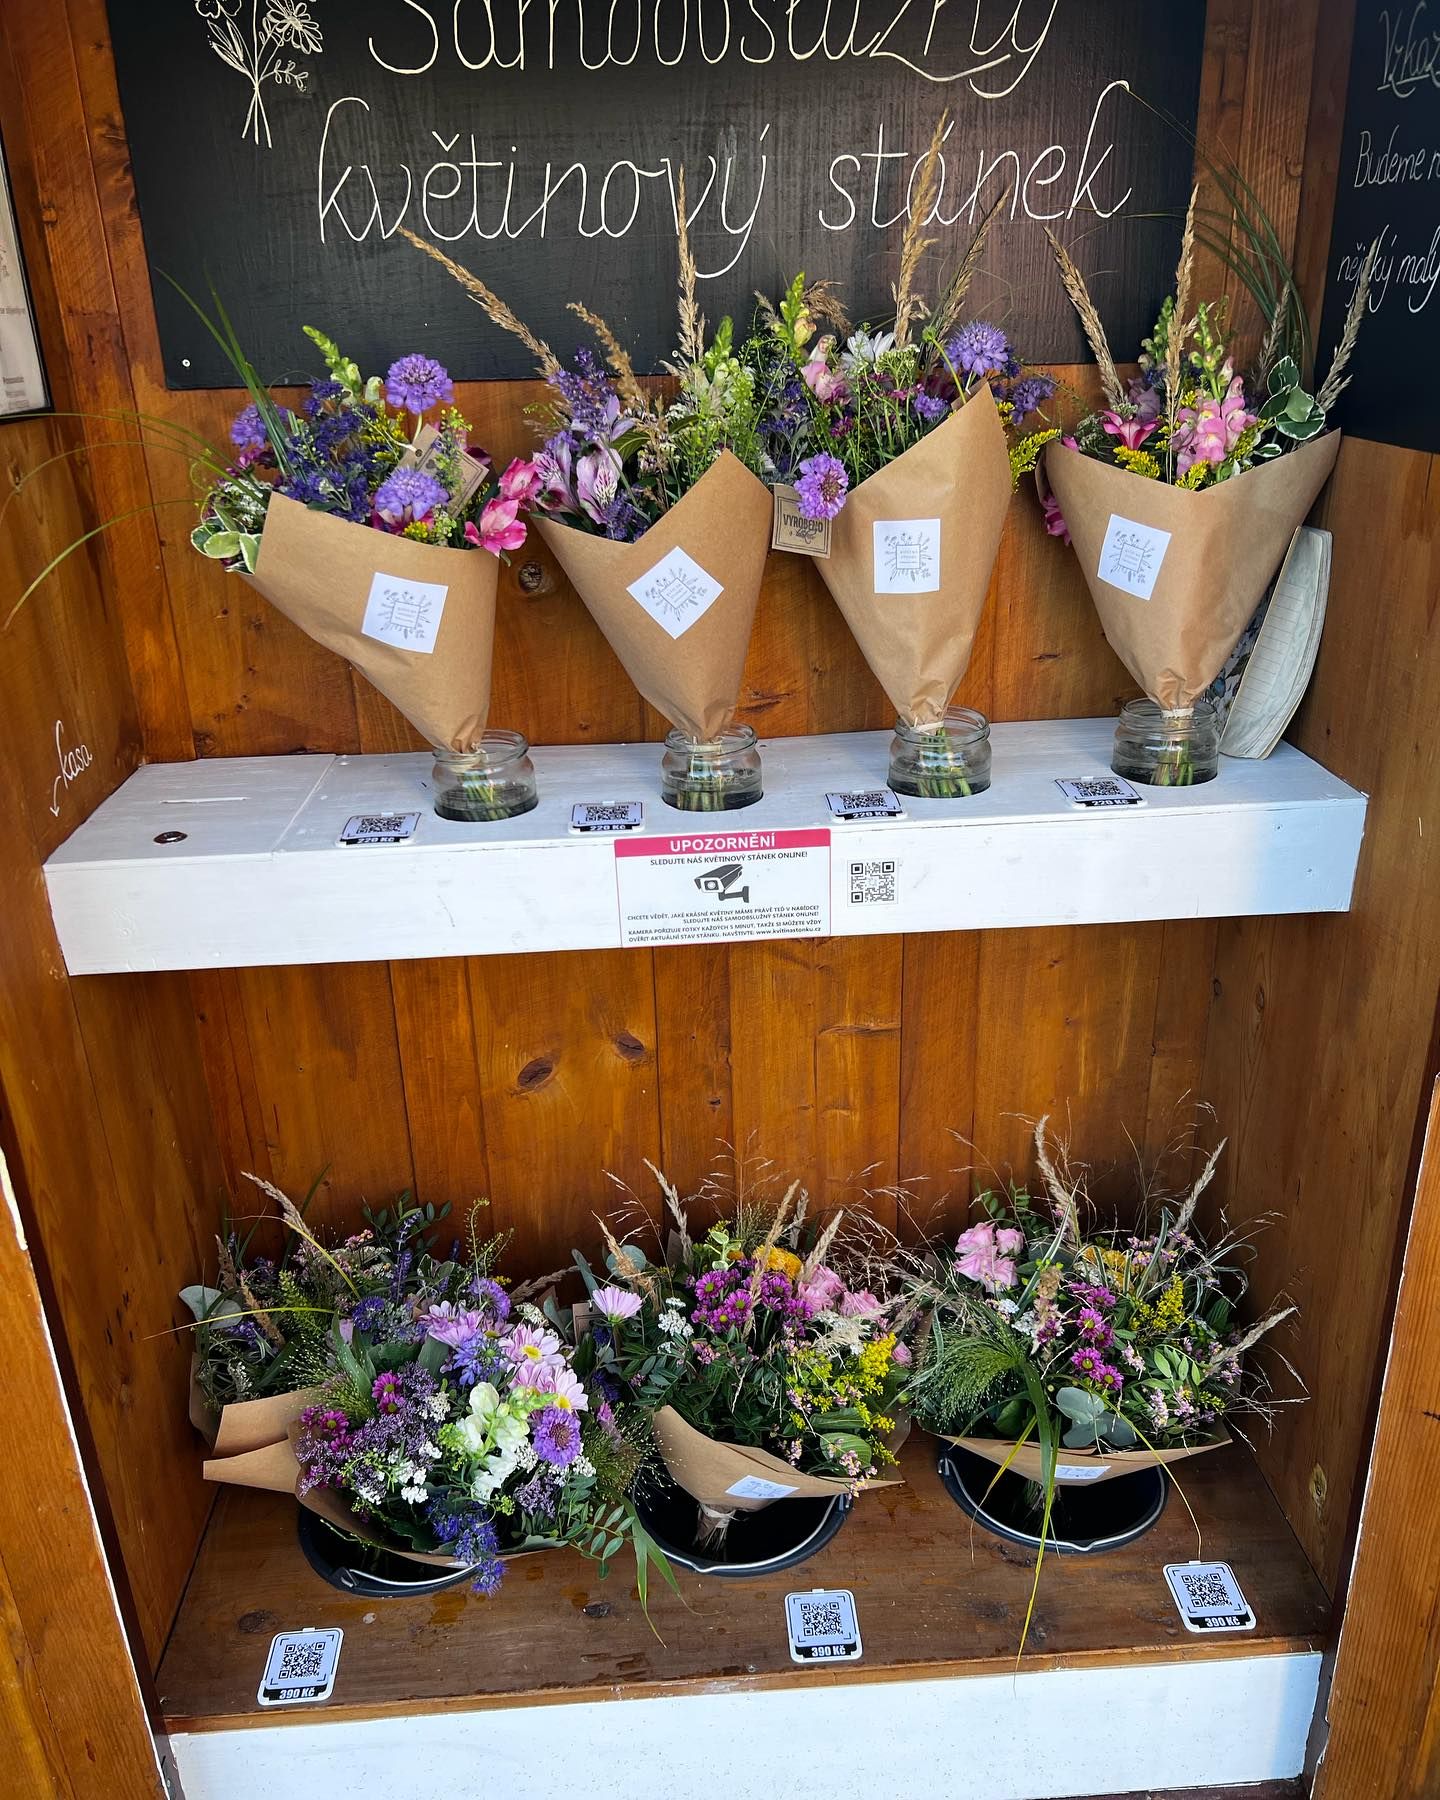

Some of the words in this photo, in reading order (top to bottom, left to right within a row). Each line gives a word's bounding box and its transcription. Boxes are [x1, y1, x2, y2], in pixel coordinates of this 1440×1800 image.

[1354, 124, 1424, 188] Budeme
[318, 97, 770, 279] květinový
[819, 79, 1132, 231] stánek
[55, 719, 93, 790] kasa
[670, 832, 776, 852] UPOZORNĚNÍ
[650, 857, 686, 866] SLEDUJTE
[686, 855, 703, 864] NÁŠ
[704, 853, 746, 864] KVĚTINOVÝ
[747, 851, 776, 861] STÁNEK
[777, 850, 808, 860] ONLINE!
[1204, 1616, 1226, 1628] 390
[1225, 1615, 1241, 1626] Kč
[811, 1645, 832, 1657] 390
[832, 1644, 846, 1656] Kč
[279, 1688, 300, 1700] 390
[301, 1686, 315, 1698] Kč
